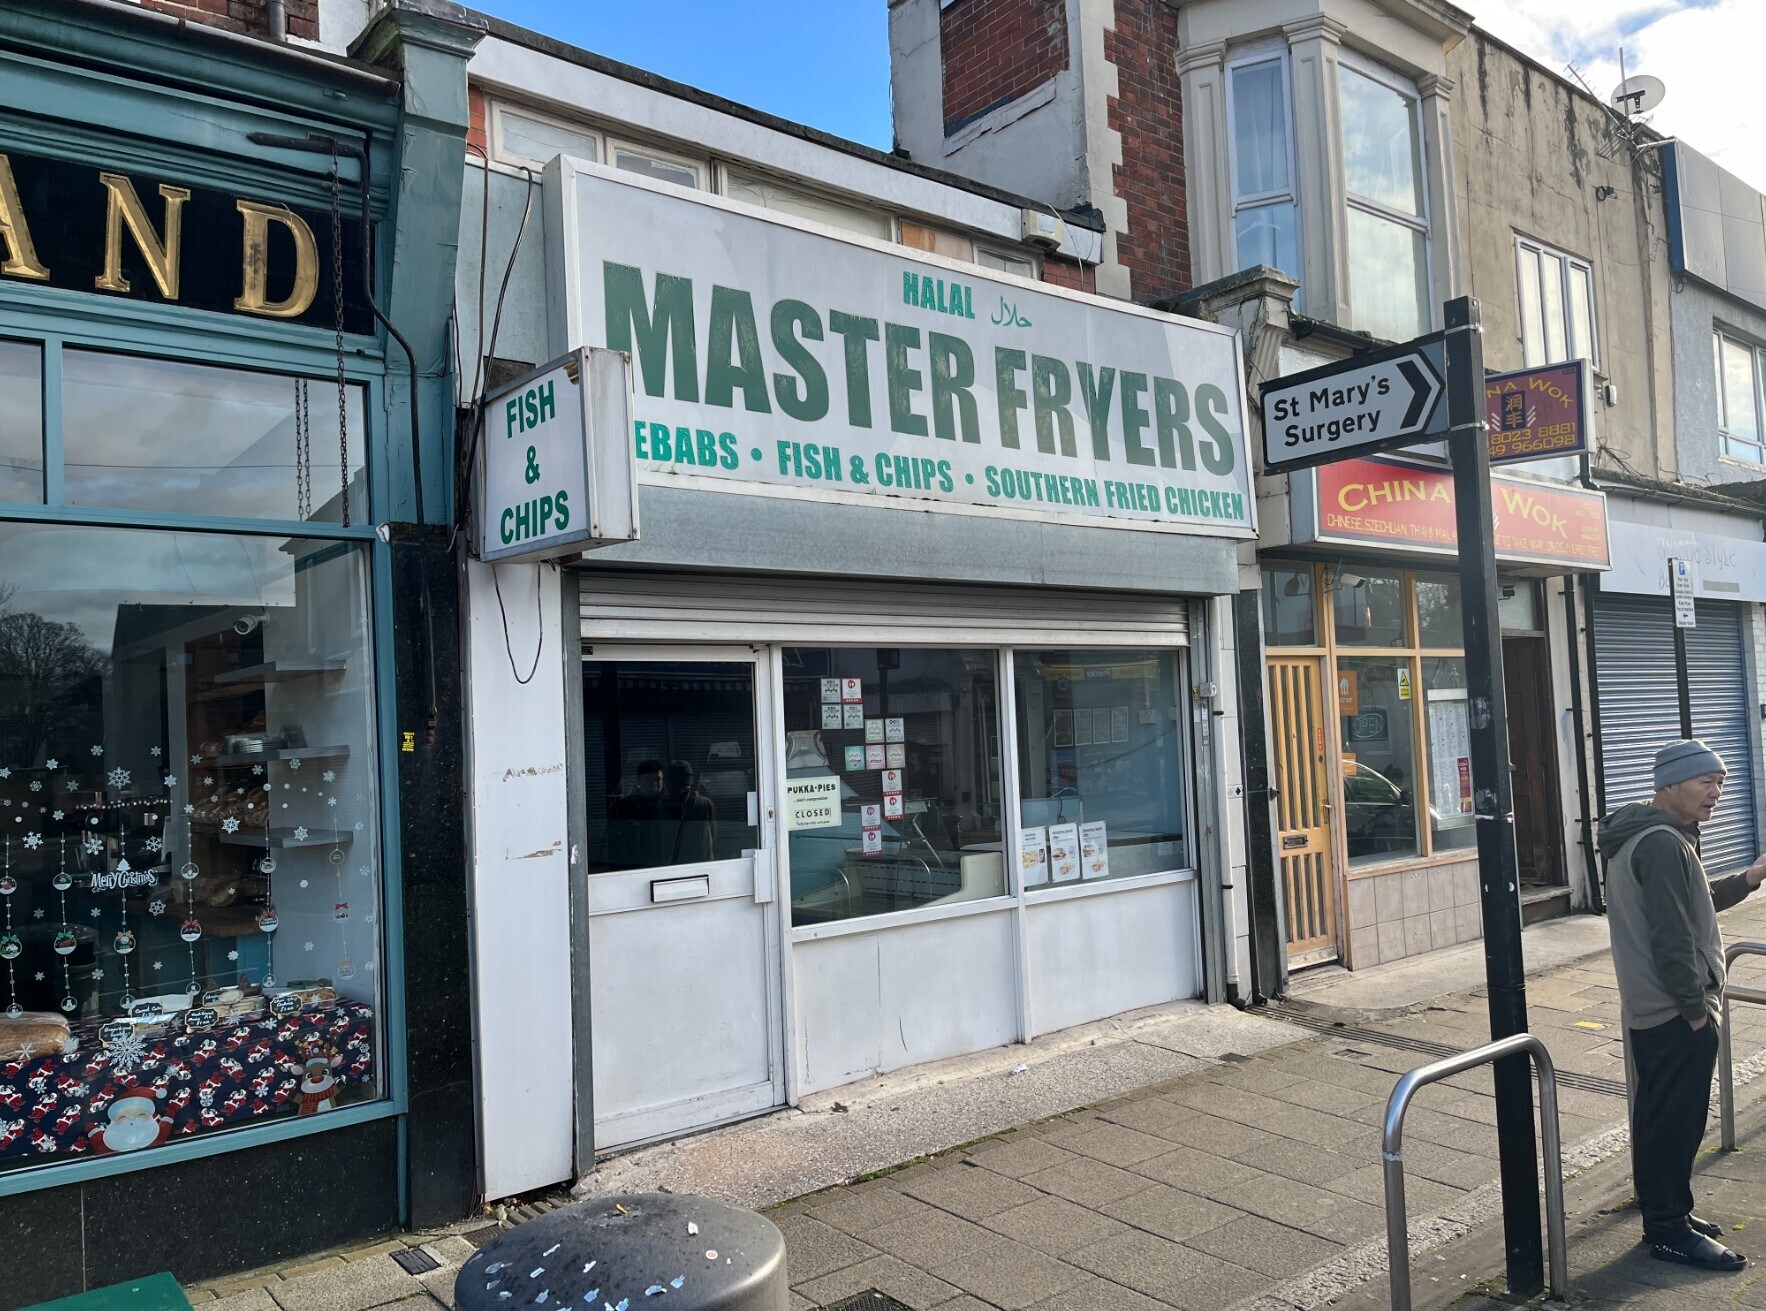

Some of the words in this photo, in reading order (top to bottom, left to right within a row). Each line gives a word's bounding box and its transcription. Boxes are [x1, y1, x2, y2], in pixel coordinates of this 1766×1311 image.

[903, 271, 975, 319] HALAL
[990, 295, 1033, 328] حلال
[603, 260, 981, 445] MASTER
[995, 346, 1235, 476] FRYERS
[506, 379, 556, 438] FISH
[1273, 396, 1300, 421] St
[1309, 375, 1390, 412] Mary's
[1528, 377, 1574, 409] WOK
[1284, 409, 1381, 447] Surgery
[1511, 434, 1576, 453] 966098
[525, 445, 540, 484] &
[634, 420, 739, 470] EBABS
[776, 440, 842, 481] FISH
[849, 455, 870, 484] &
[875, 452, 953, 493] CHIPS
[985, 465, 1100, 507] SOUTHERN
[1105, 480, 1161, 513] FRIED
[1164, 486, 1245, 520] CHICKEN
[500, 490, 570, 545] CHIPS
[1337, 480, 1452, 512] CHINA
[1500, 487, 1568, 539] WOK
[795, 808, 830, 819] CLOSED
